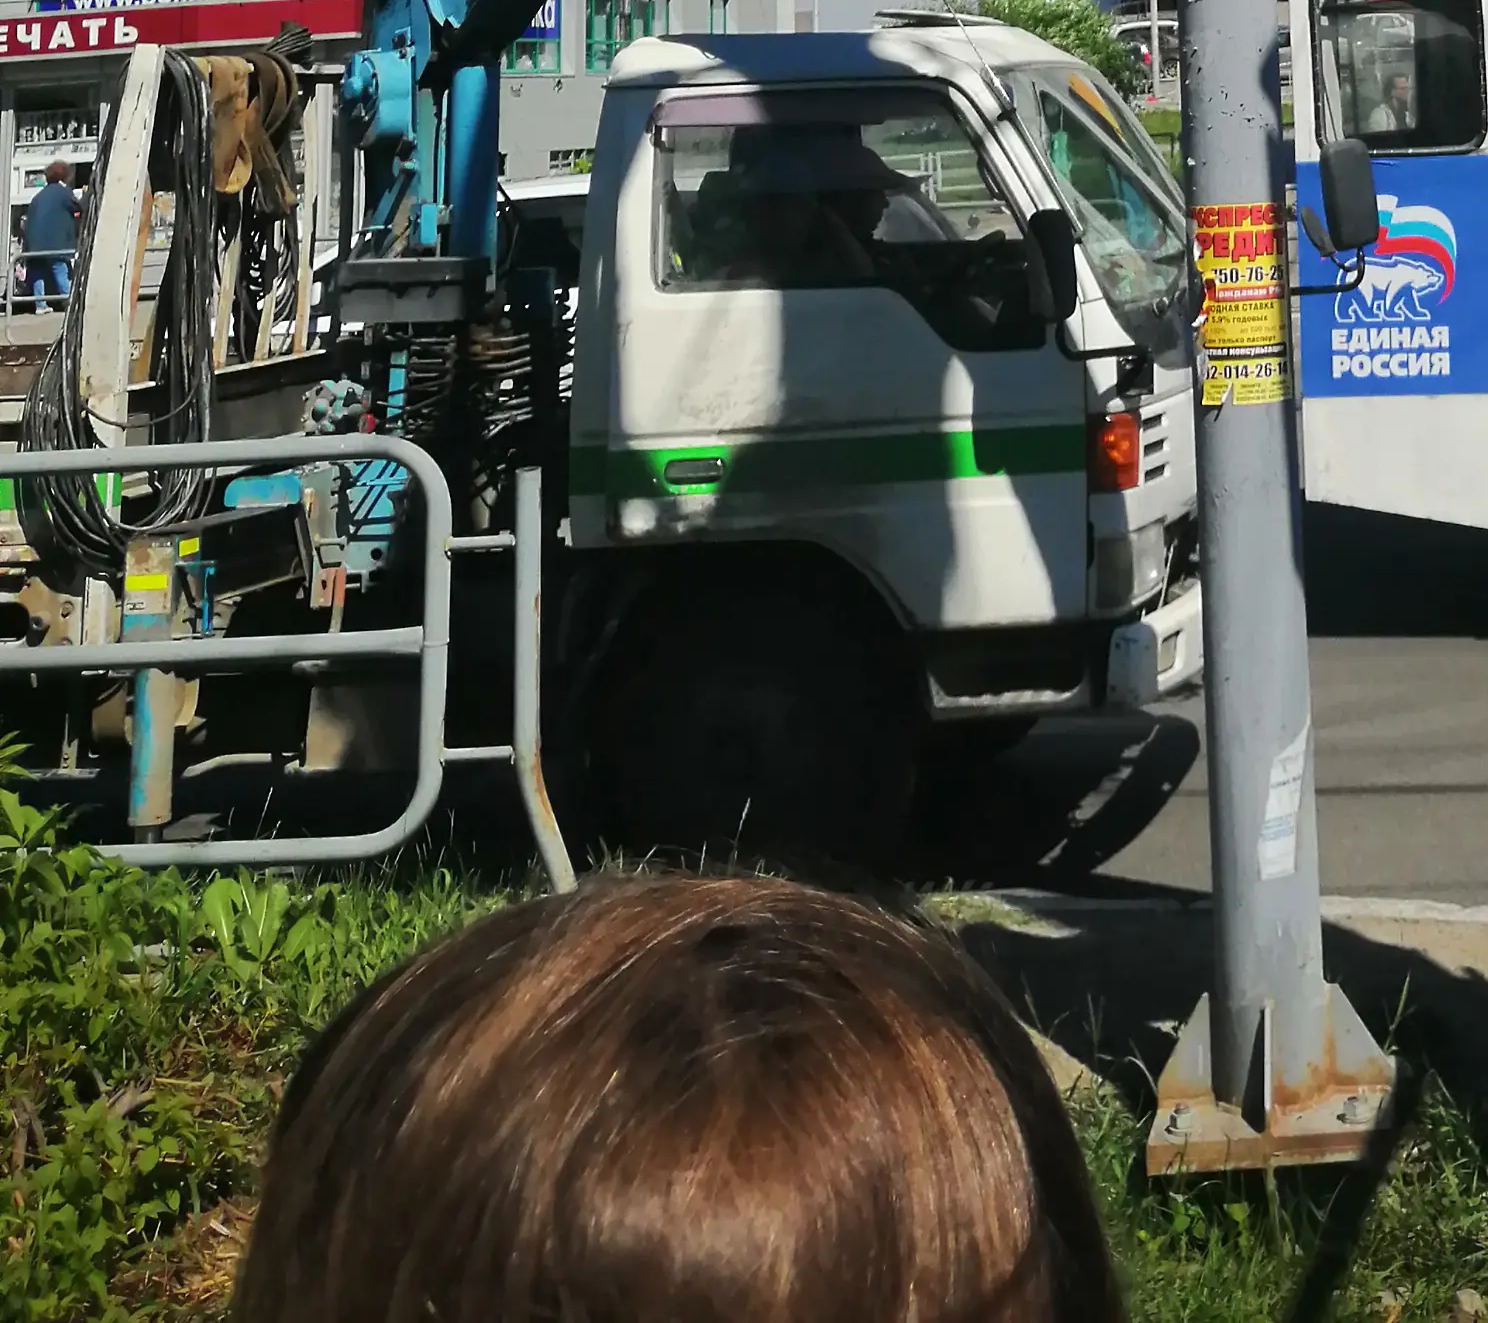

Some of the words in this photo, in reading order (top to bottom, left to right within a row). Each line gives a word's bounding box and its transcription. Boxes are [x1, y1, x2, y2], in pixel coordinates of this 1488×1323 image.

[1196, 229, 1284, 263] РЕДИТ
[1331, 326, 1449, 353] ЕДИНАЯ
[1332, 352, 1450, 378] РОССИЯ
